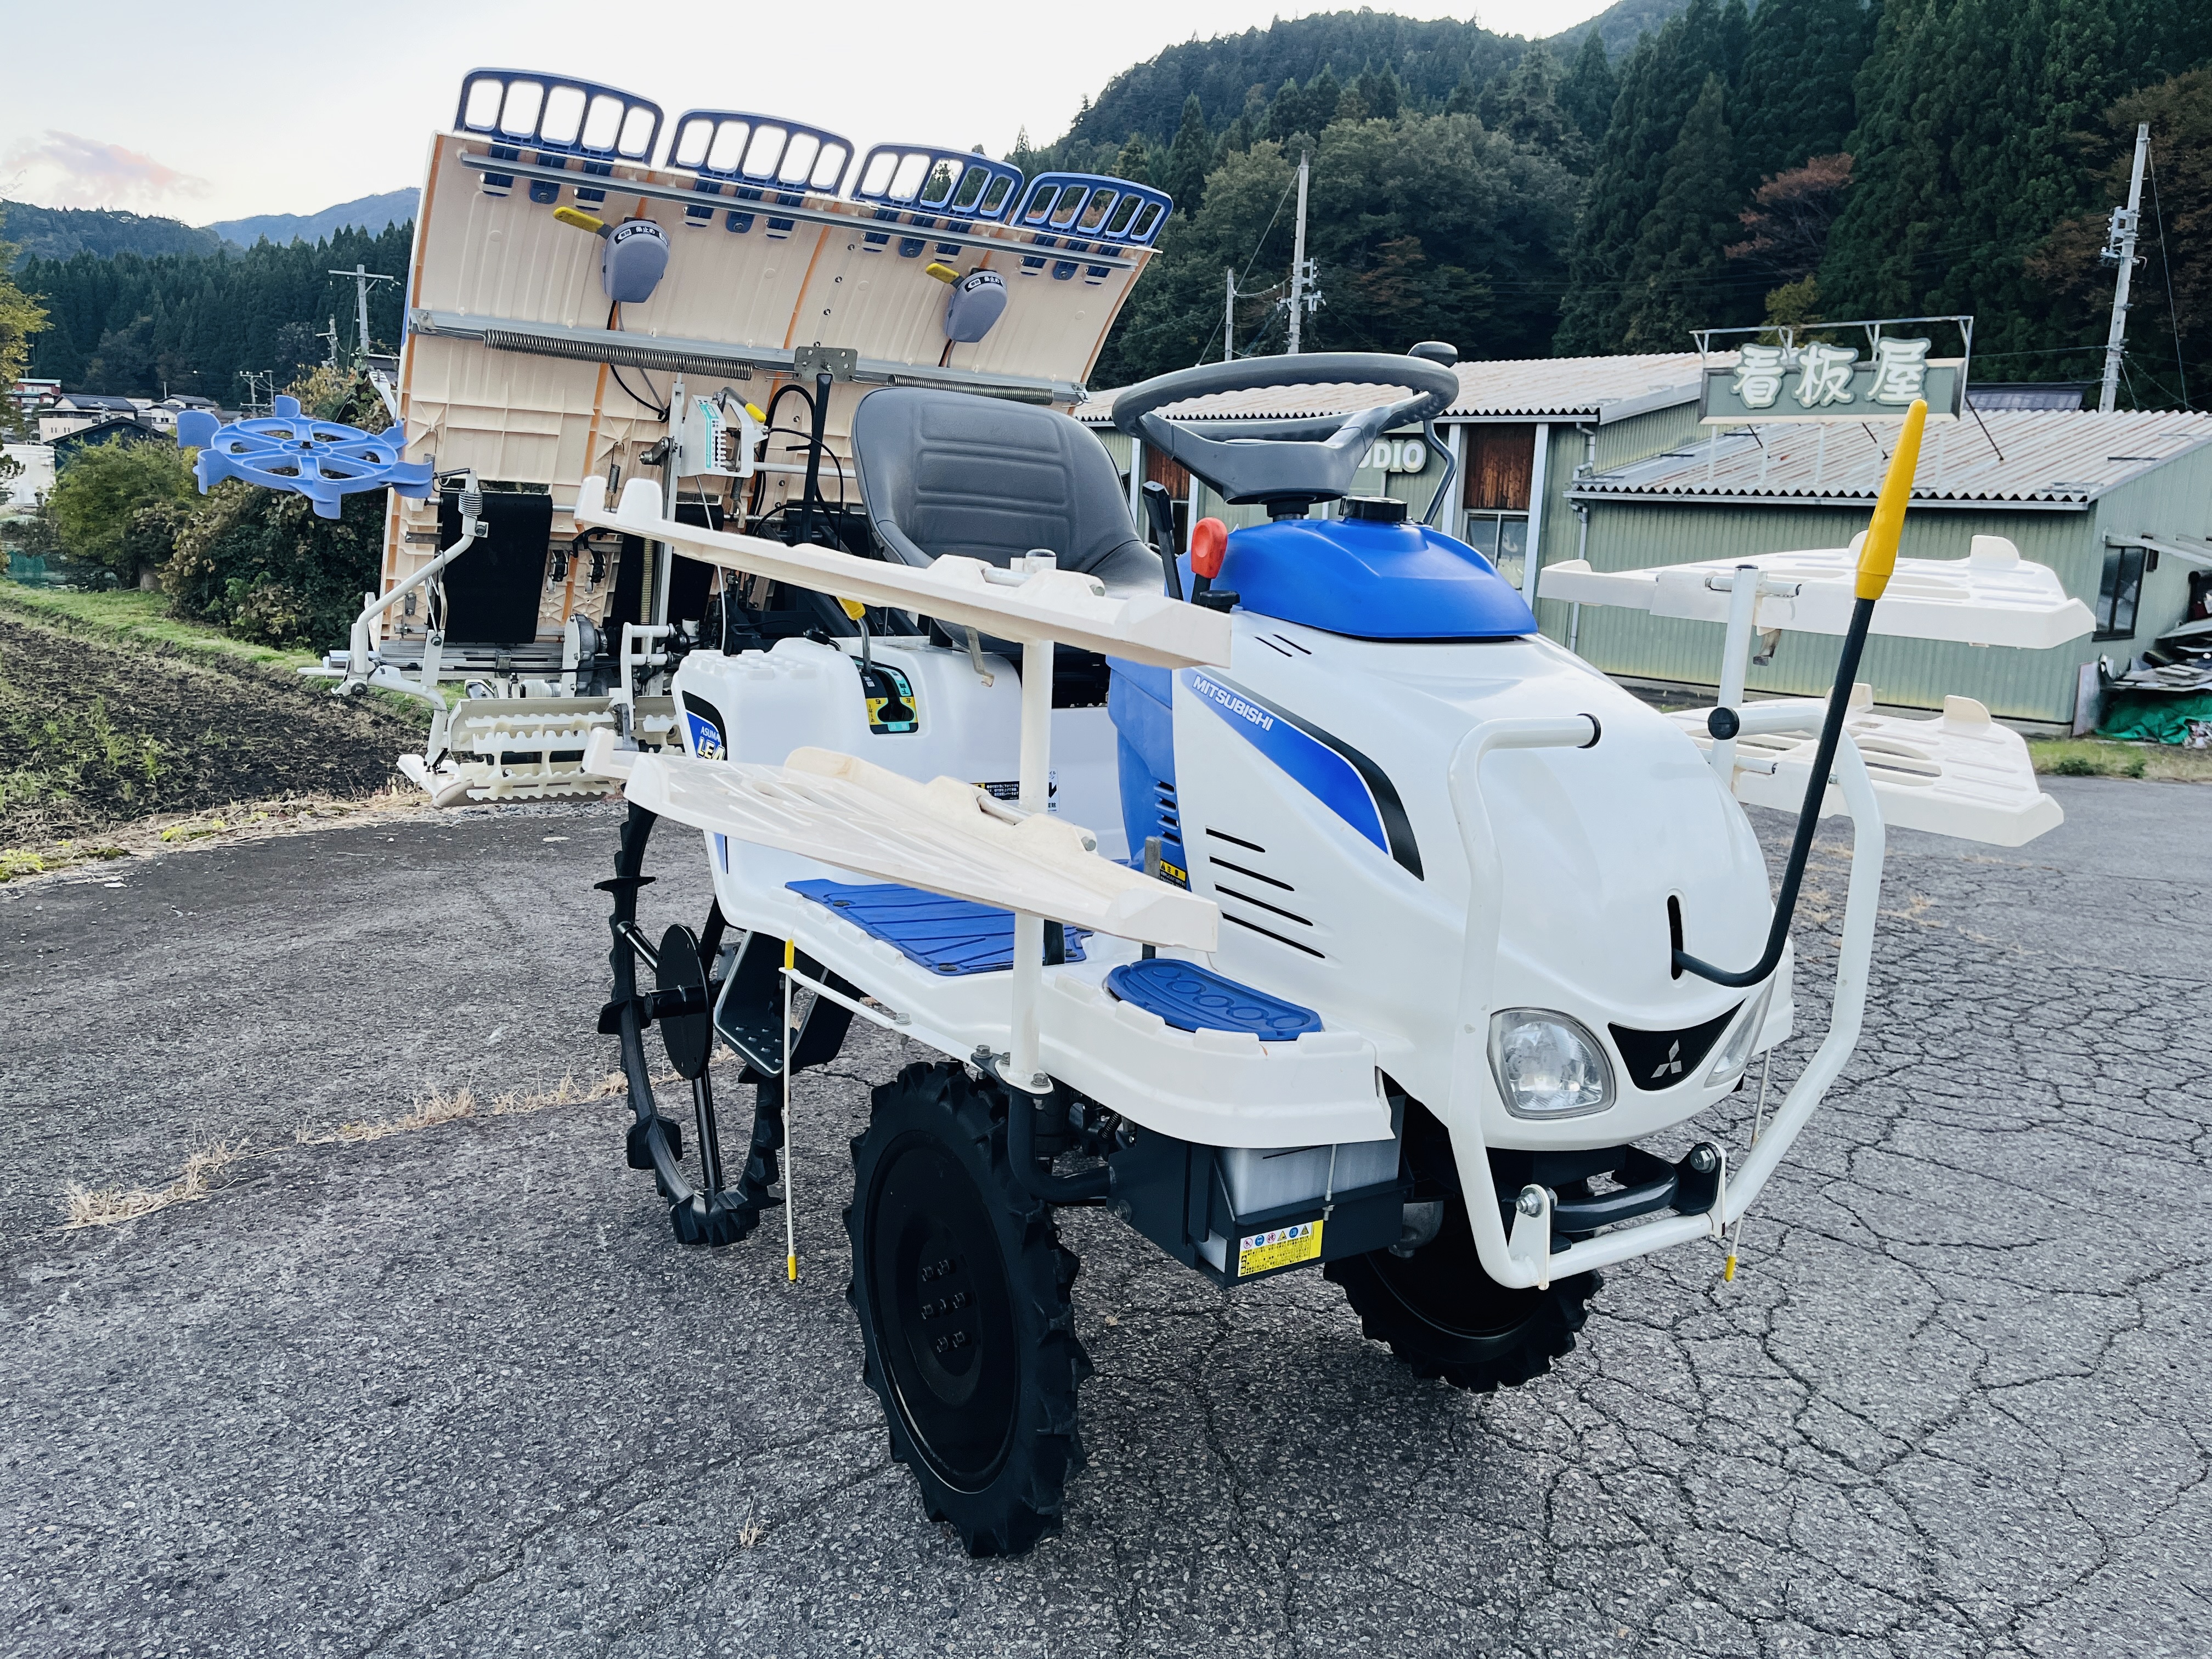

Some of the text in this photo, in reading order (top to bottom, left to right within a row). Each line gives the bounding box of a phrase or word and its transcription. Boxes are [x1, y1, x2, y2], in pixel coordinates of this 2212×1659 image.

[1731, 337, 1930, 407] 看板屋
[1192, 674, 1274, 732] MITSUBISHI
[700, 726, 720, 742] ASUMA
